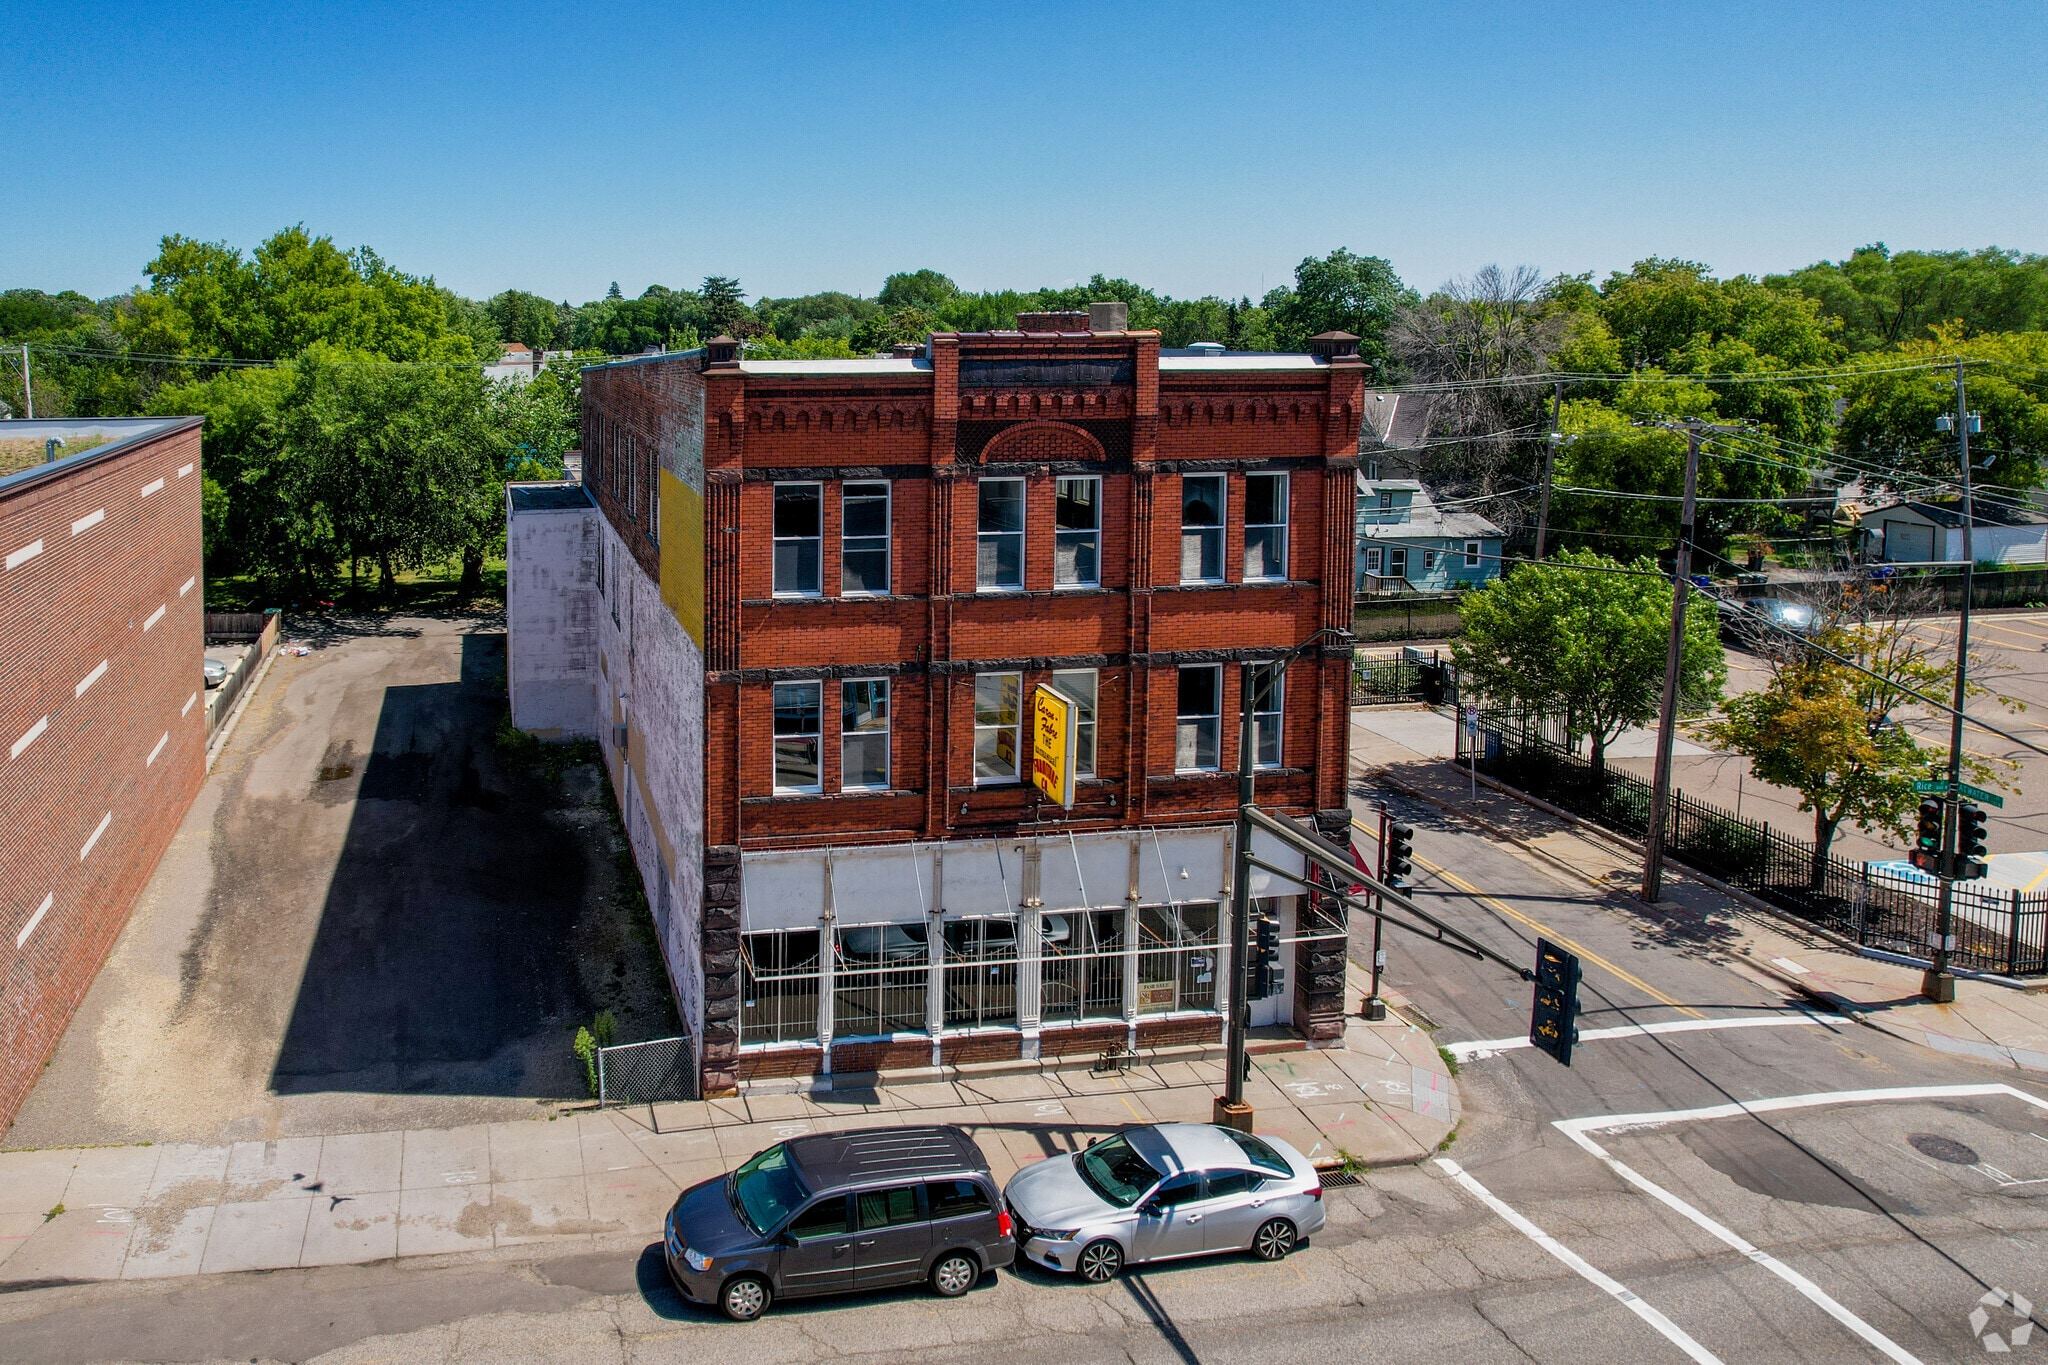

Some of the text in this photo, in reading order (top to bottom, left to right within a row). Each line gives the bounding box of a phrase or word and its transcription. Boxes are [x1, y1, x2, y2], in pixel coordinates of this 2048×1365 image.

[1042, 734, 1052, 749] THE
[1916, 781, 1932, 790] Rice
[1958, 784, 1990, 802] ATWATER
